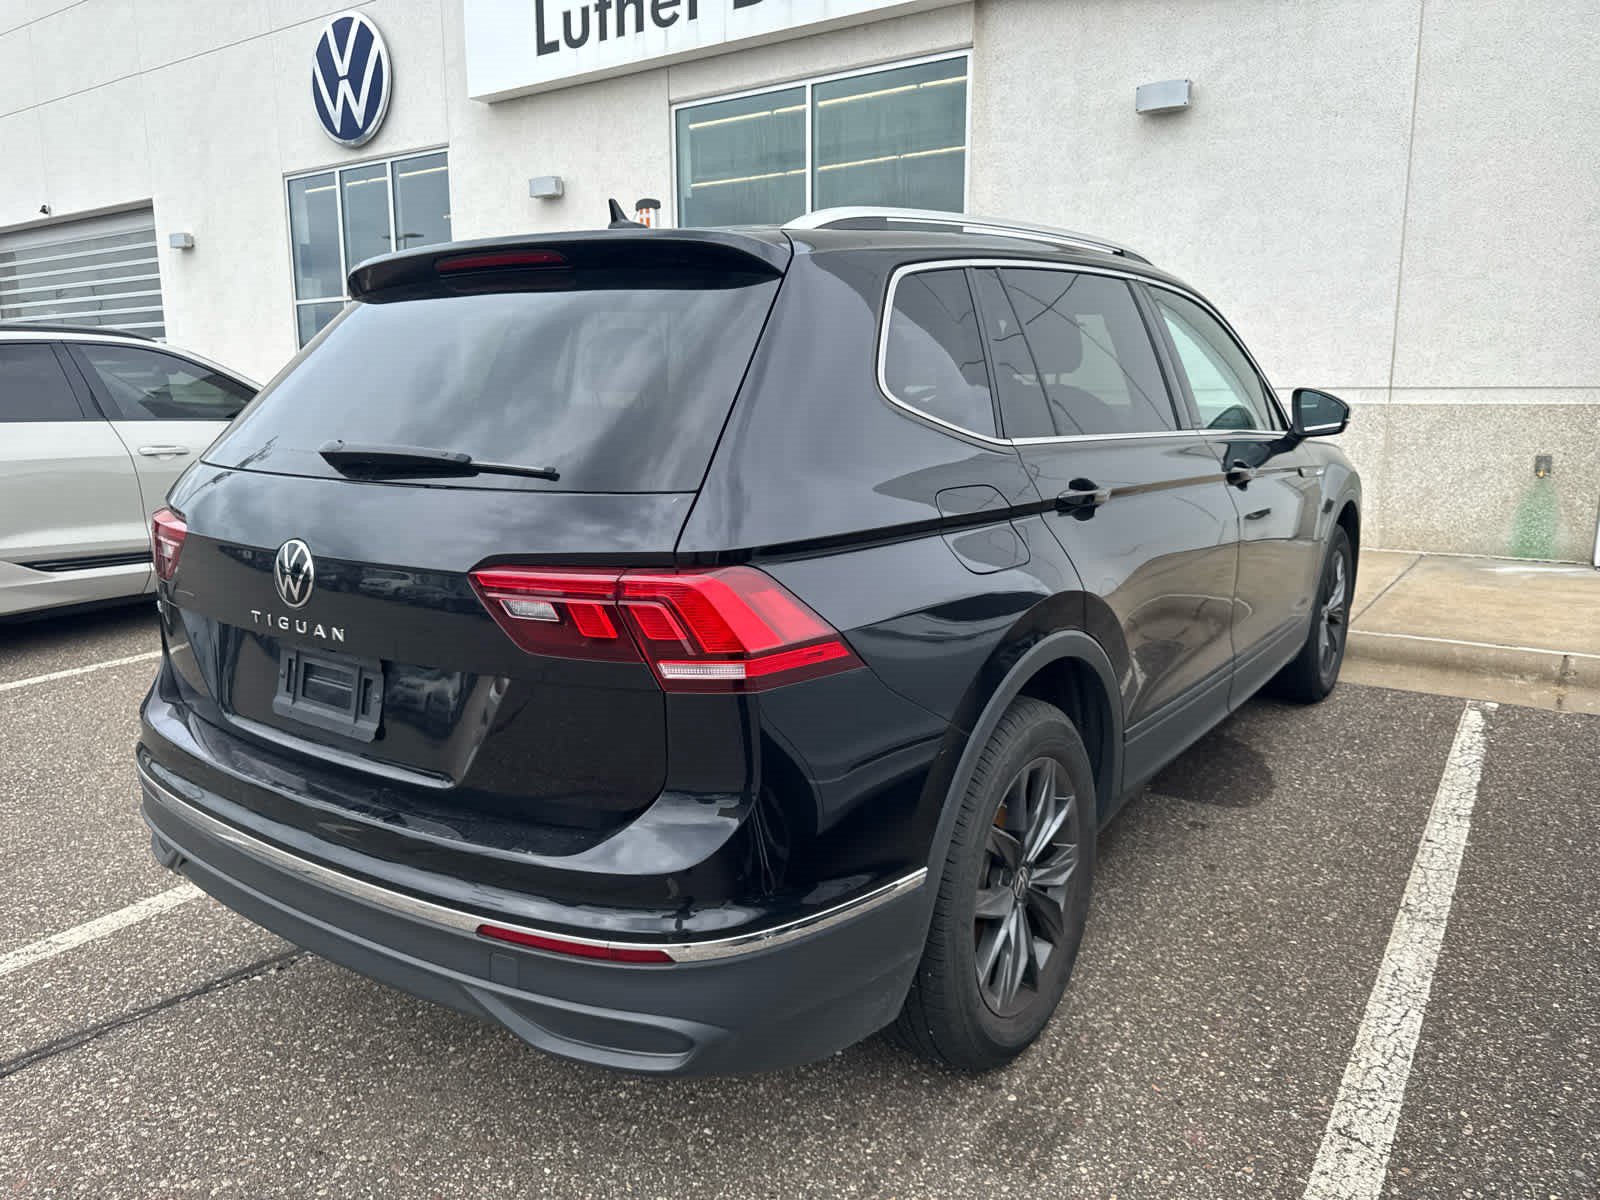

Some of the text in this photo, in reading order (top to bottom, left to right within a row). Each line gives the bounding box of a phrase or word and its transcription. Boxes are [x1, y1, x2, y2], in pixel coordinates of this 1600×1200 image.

[312, 11, 389, 145] VW
[275, 539, 315, 608] VW
[251, 610, 345, 642] TIGUAN
